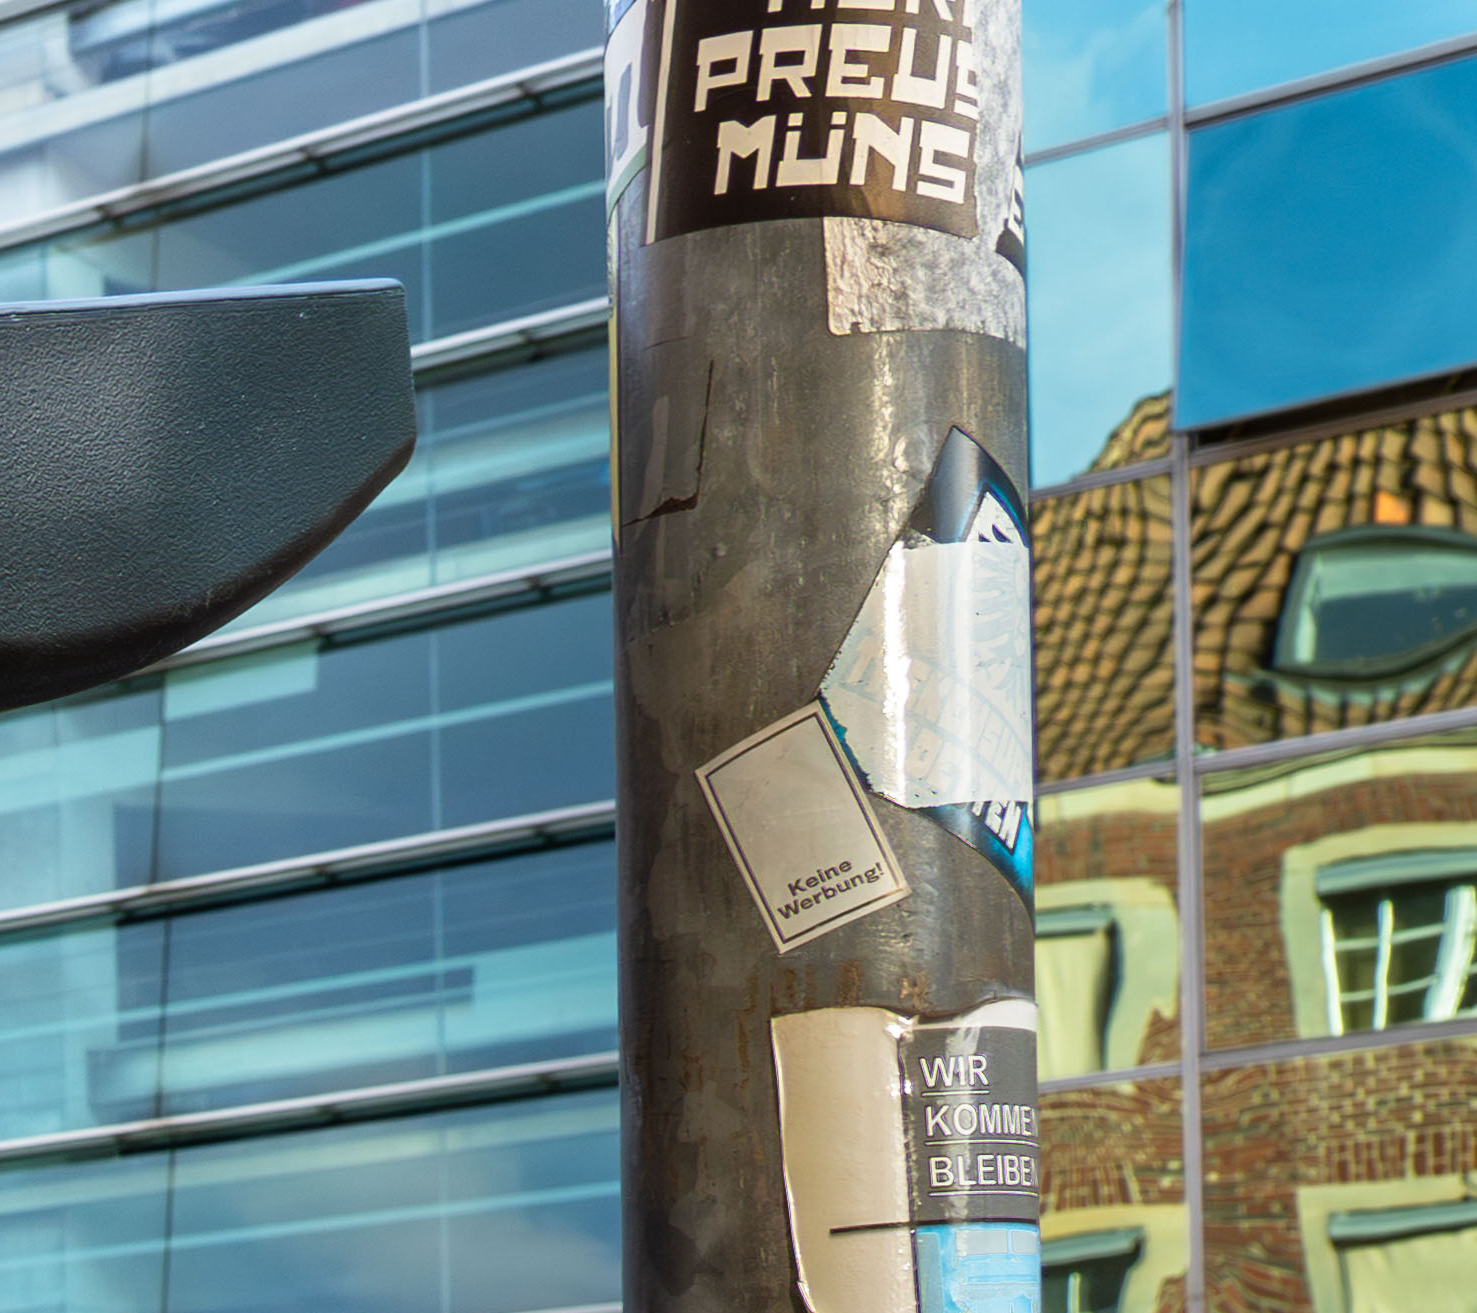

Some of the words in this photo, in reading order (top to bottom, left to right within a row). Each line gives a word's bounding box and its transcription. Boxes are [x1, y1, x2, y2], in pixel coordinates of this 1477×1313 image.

[714, 111, 970, 204] MÜNS
[777, 862, 884, 919] Werbung!
[788, 860, 852, 896] Keine
[920, 1055, 989, 1088] WIR
